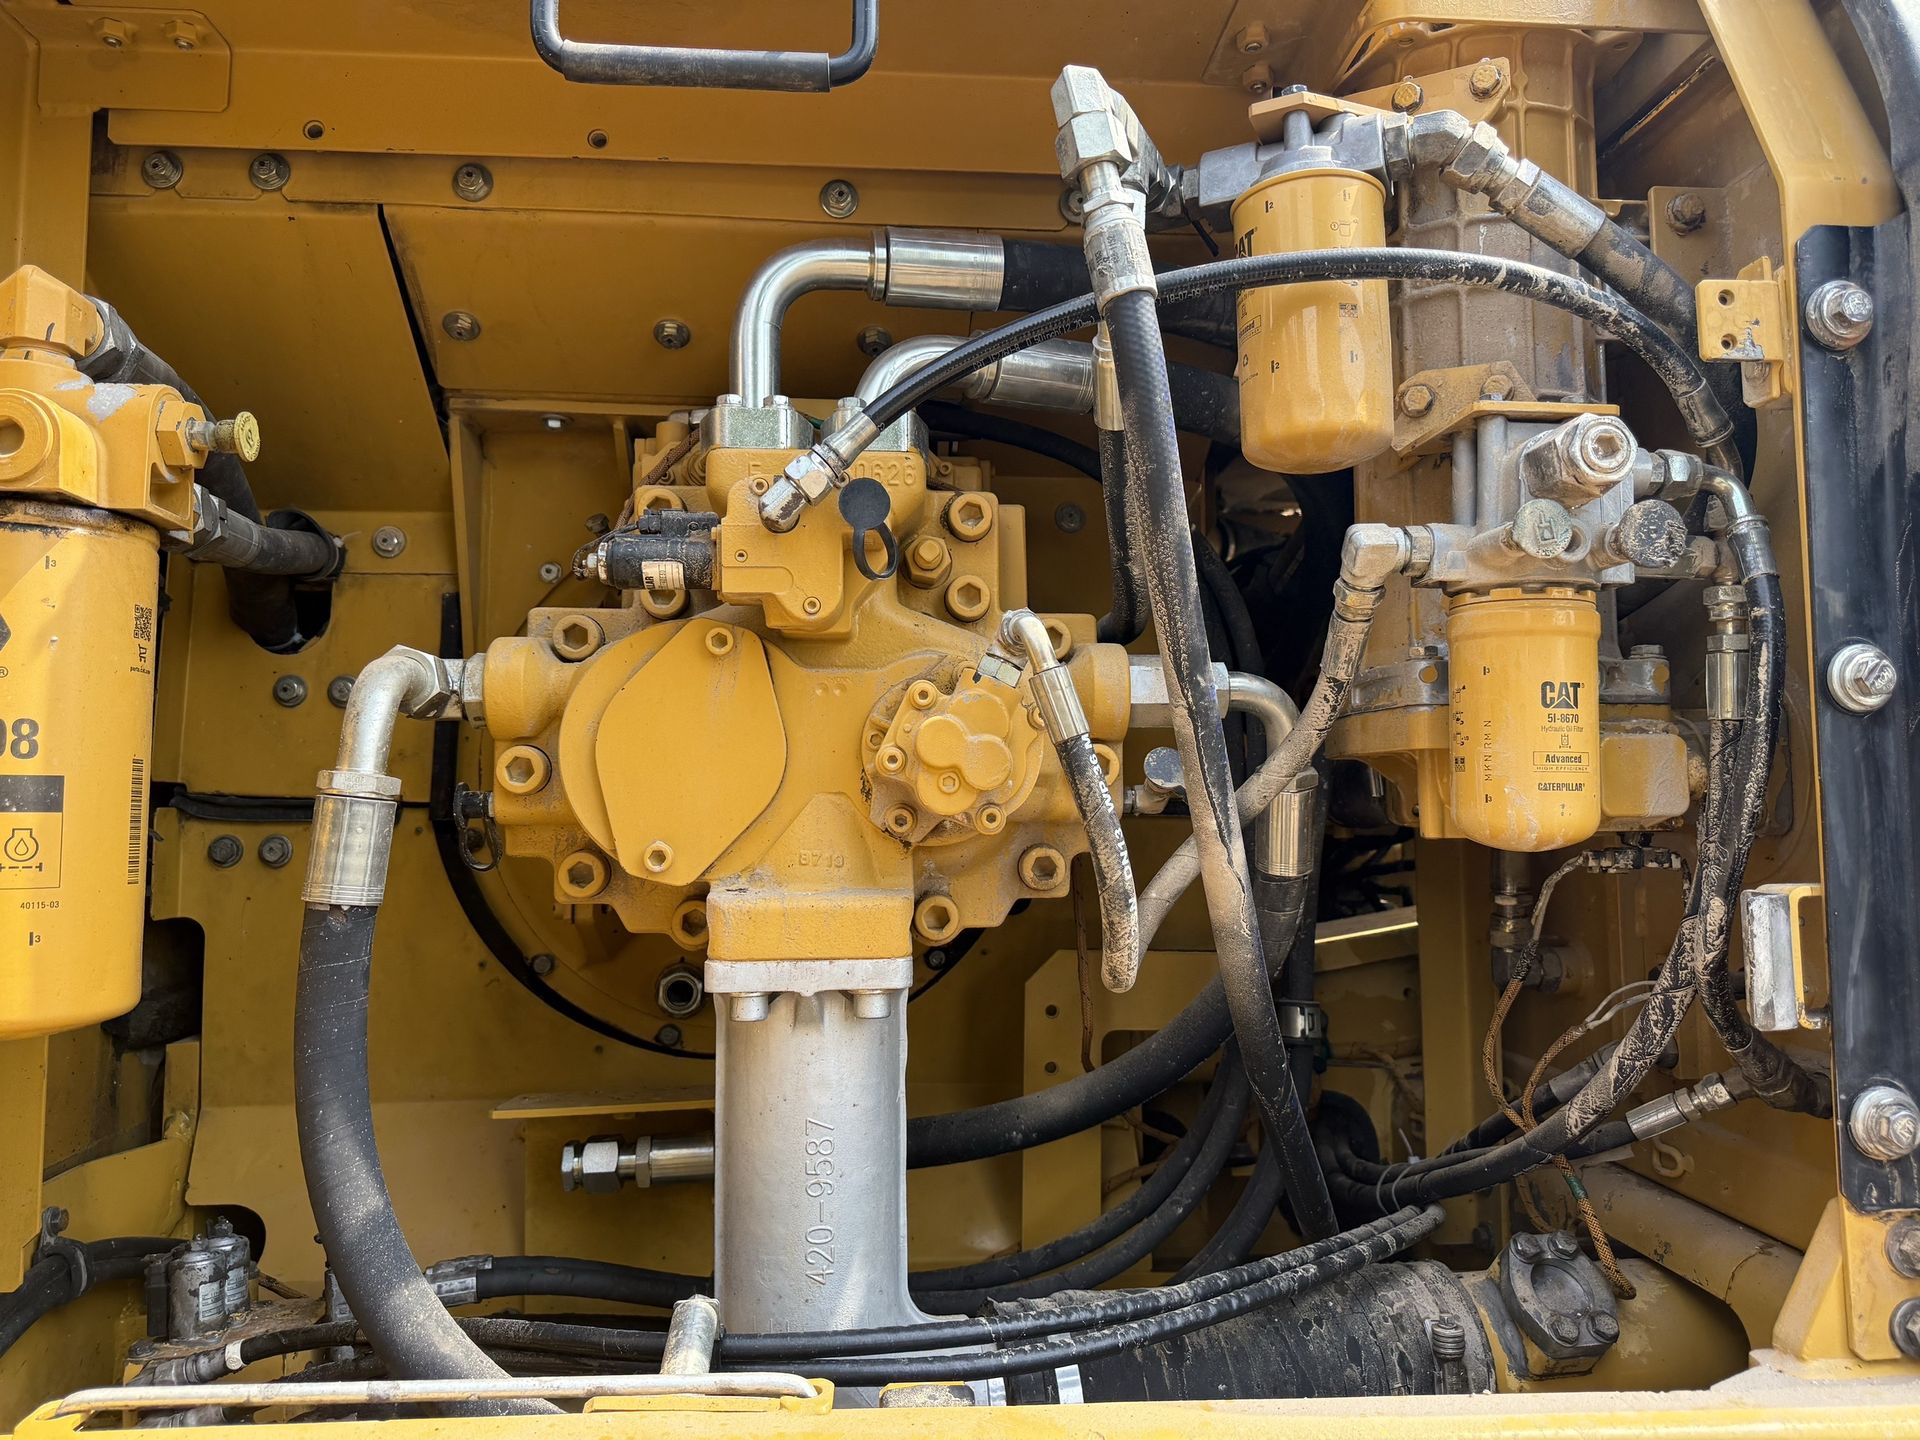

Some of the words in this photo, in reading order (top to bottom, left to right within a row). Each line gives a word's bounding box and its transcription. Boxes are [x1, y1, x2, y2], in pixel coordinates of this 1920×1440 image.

[1541, 681, 1580, 709] CAT
[1541, 725, 1565, 734] Hydraulic
[1545, 754, 1582, 764] Advanced
[1538, 782, 1583, 792] CATERPILLAR
[20, 900, 60, 910] 40115-03
[804, 1117, 836, 1286] 420-9587
